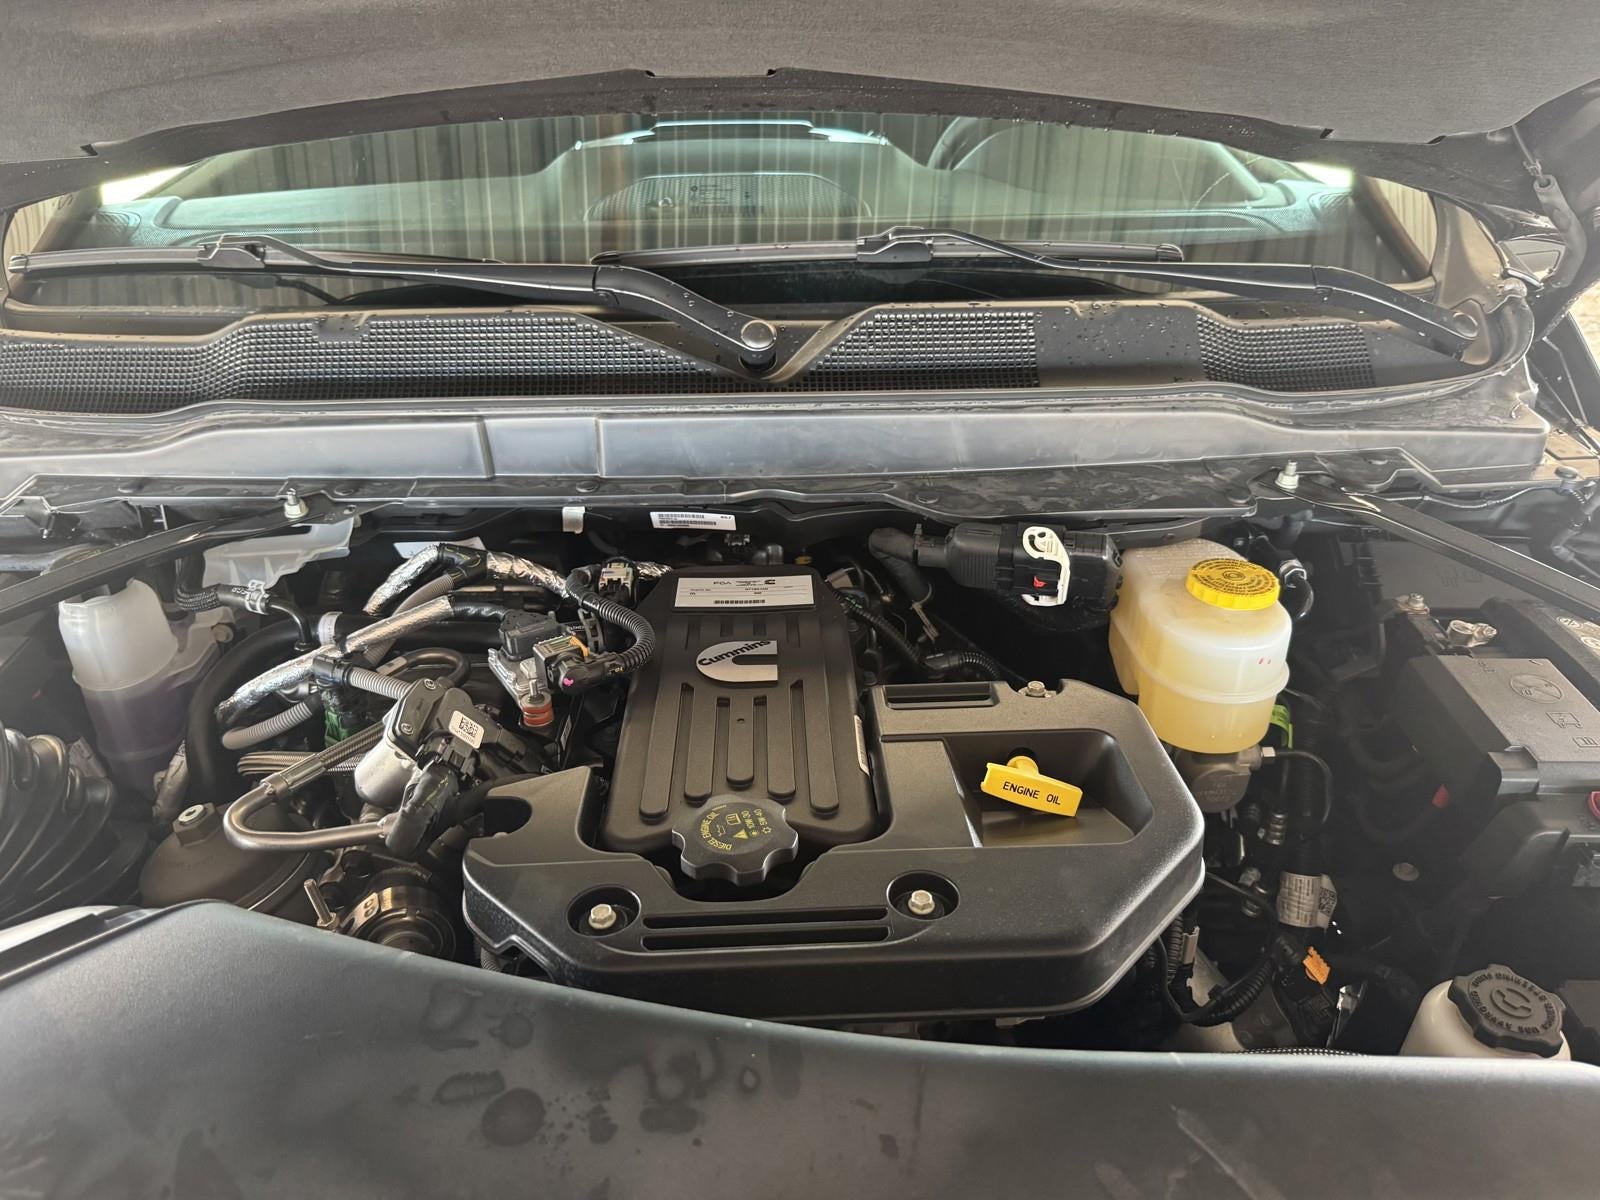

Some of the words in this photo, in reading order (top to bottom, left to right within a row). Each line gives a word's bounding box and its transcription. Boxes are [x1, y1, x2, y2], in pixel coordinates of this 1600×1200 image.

[698, 639, 771, 666] Cummins
[1002, 780, 1041, 800] ENGINE
[1046, 793, 1061, 806] OIL
[706, 810, 720, 820] OIL
[700, 818, 712, 839] ENGINE
[707, 836, 733, 852] DIESEL
